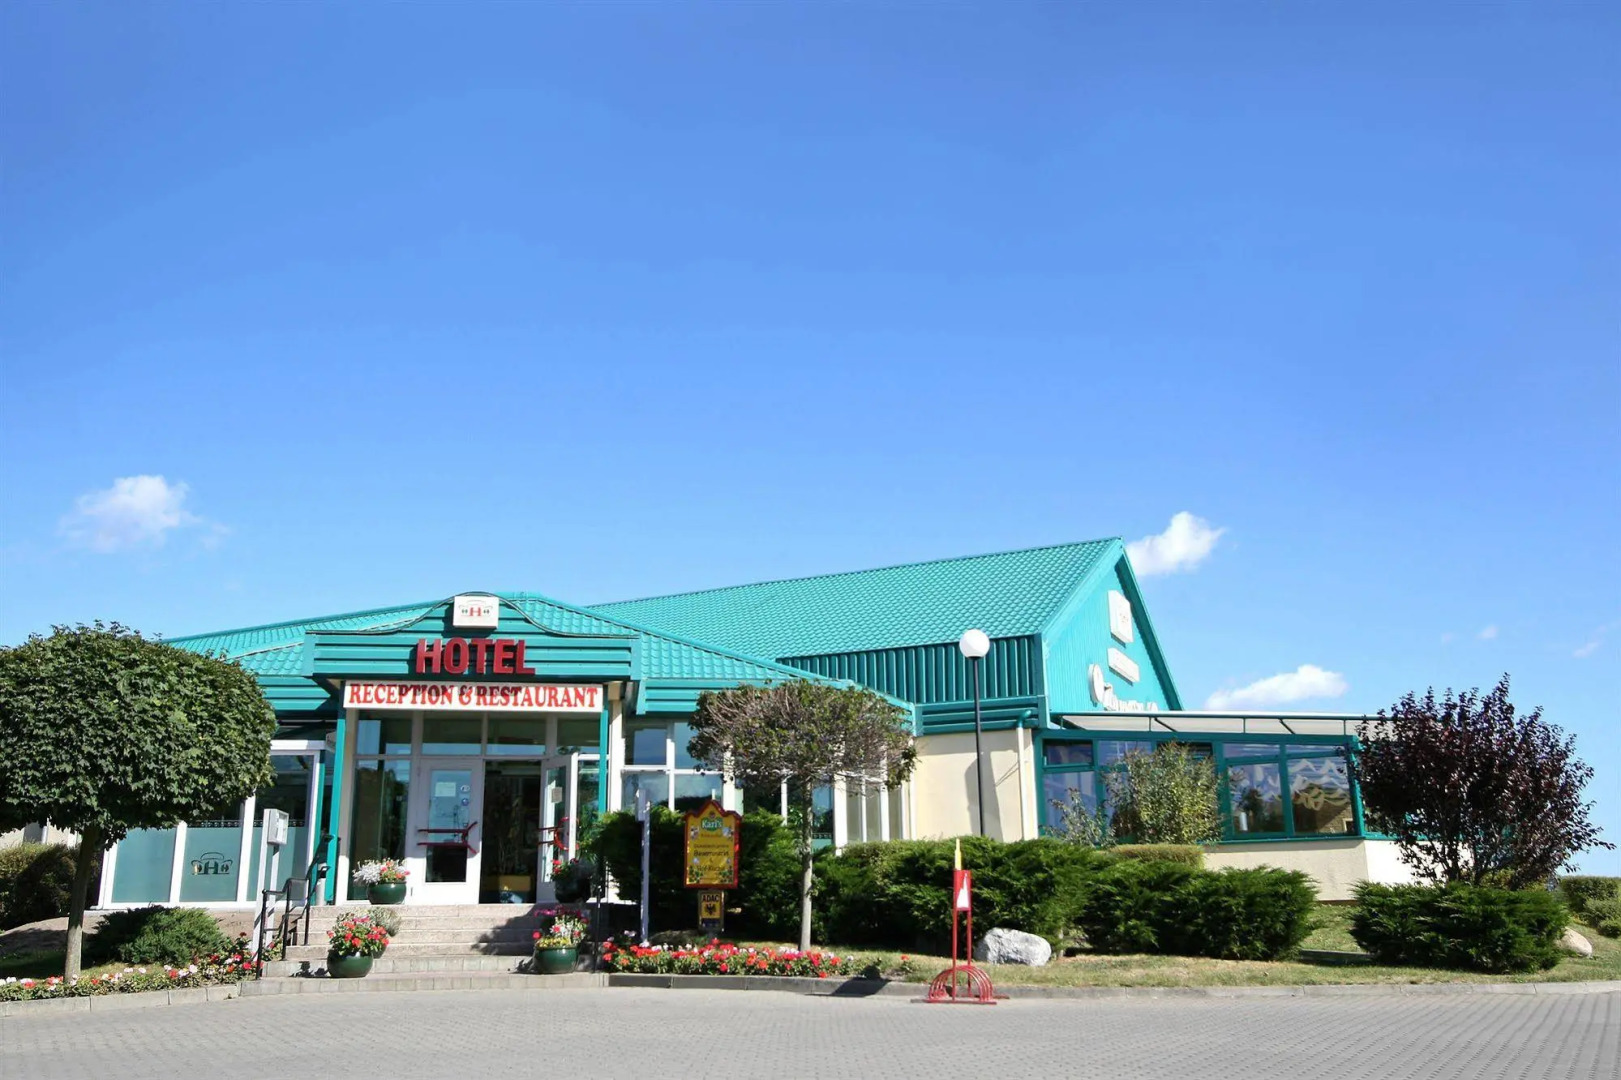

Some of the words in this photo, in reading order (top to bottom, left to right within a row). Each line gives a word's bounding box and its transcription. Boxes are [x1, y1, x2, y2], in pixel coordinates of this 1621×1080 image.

[415, 637, 536, 675] HOTEL
[349, 683, 455, 705] RECEPTION
[459, 684, 473, 706] &
[475, 685, 598, 708] RESTAURANT
[702, 894, 719, 902] ADAC
